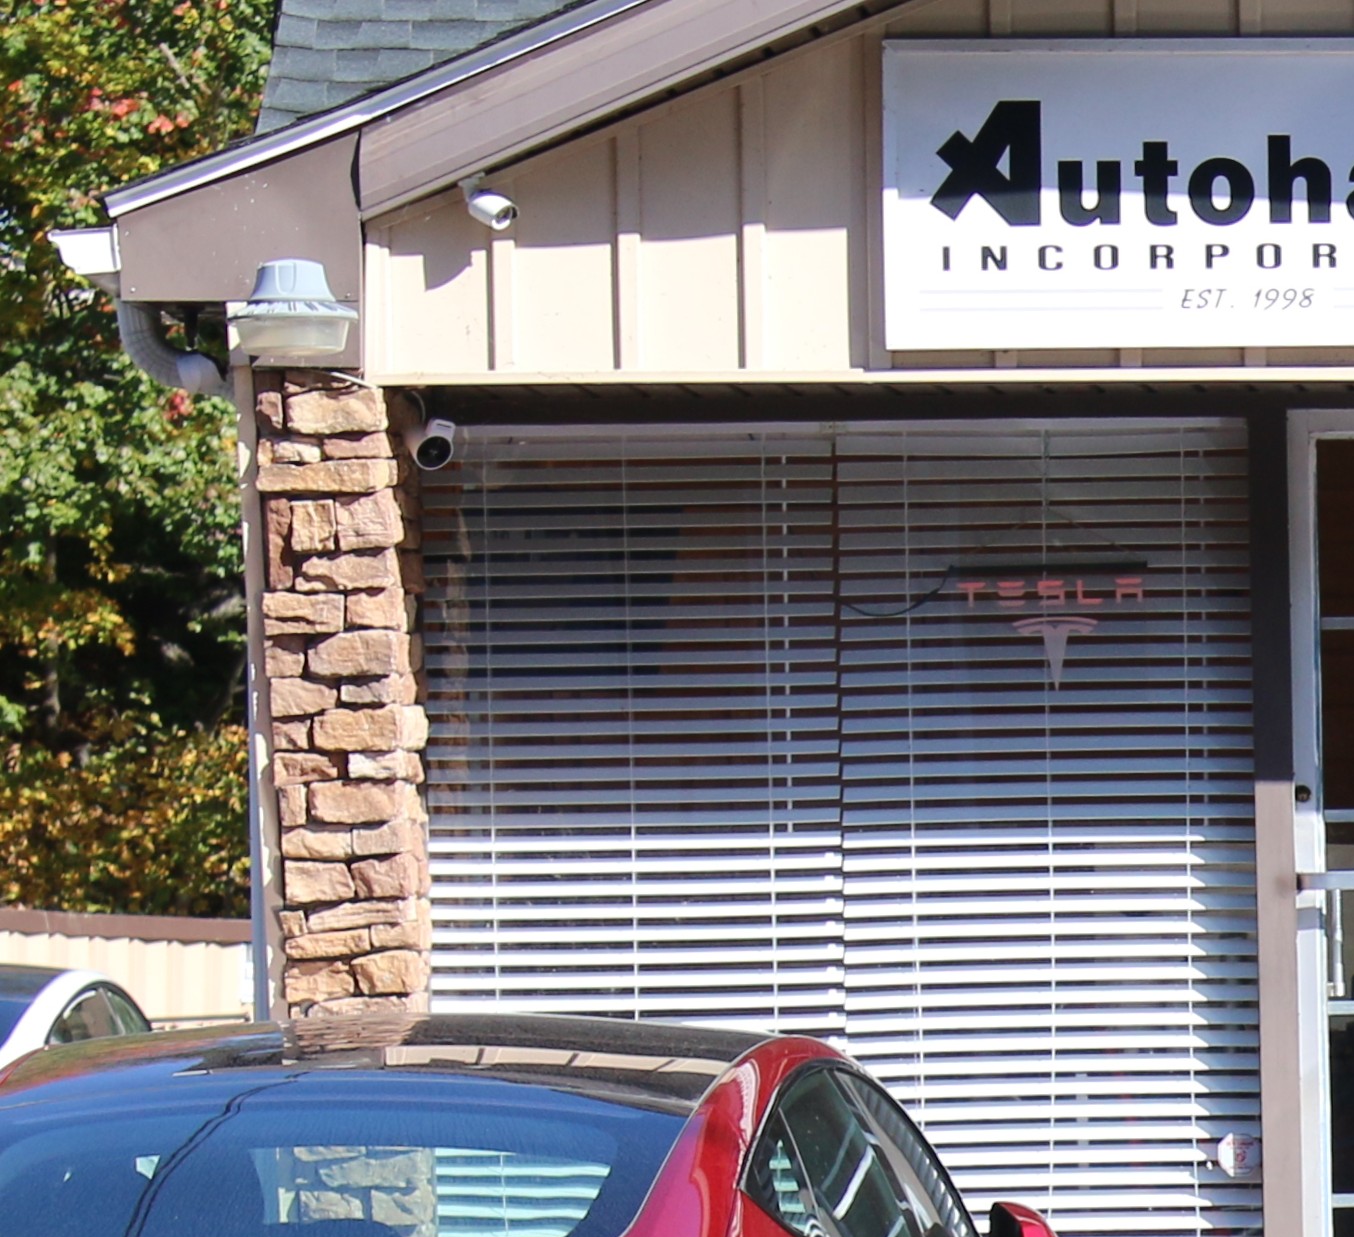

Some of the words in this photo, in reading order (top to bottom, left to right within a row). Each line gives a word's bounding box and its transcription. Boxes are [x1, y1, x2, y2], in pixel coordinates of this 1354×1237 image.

[1181, 288, 1234, 309] EST.
[1254, 288, 1315, 310] 1998
[957, 577, 1144, 608] TESLA
